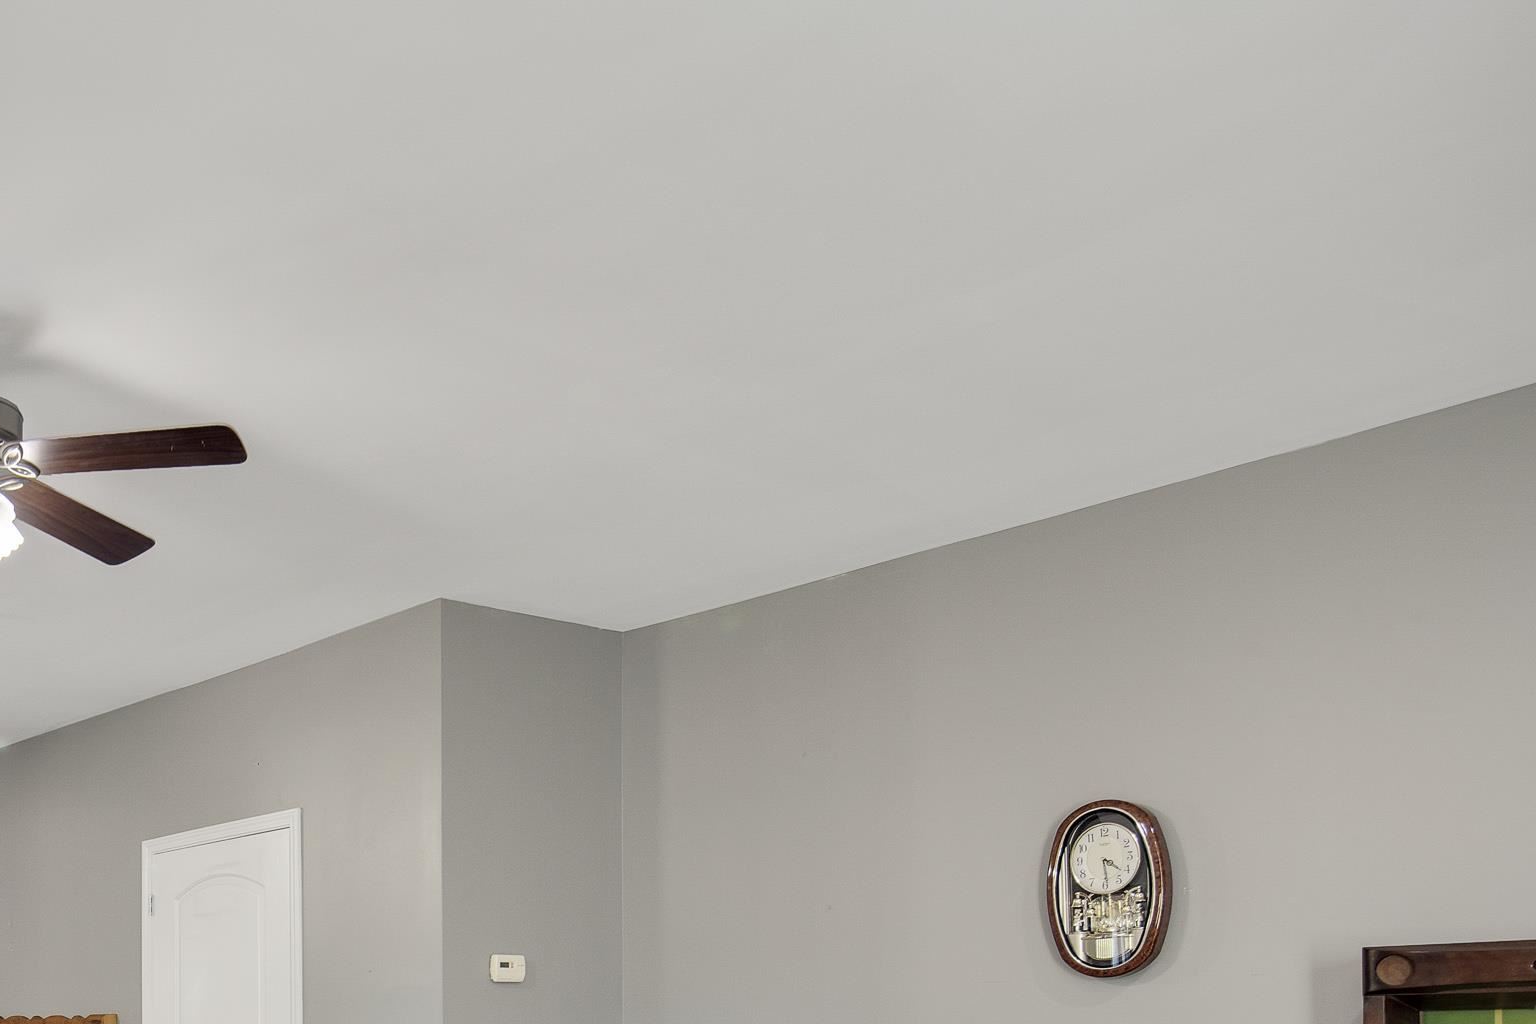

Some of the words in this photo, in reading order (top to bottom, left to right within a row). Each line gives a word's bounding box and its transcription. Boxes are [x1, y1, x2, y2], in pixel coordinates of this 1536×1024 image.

[1100, 828, 1109, 837] 12
[1088, 833, 1094, 843] 11
[1124, 839, 1130, 848] 2
[1079, 845, 1087, 853] 10
[1077, 856, 1083, 866] 9
[1124, 864, 1130, 873] 4
[1080, 870, 1086, 878] 8
[1089, 877, 1095, 887] 7
[1116, 874, 1122, 884] 5
